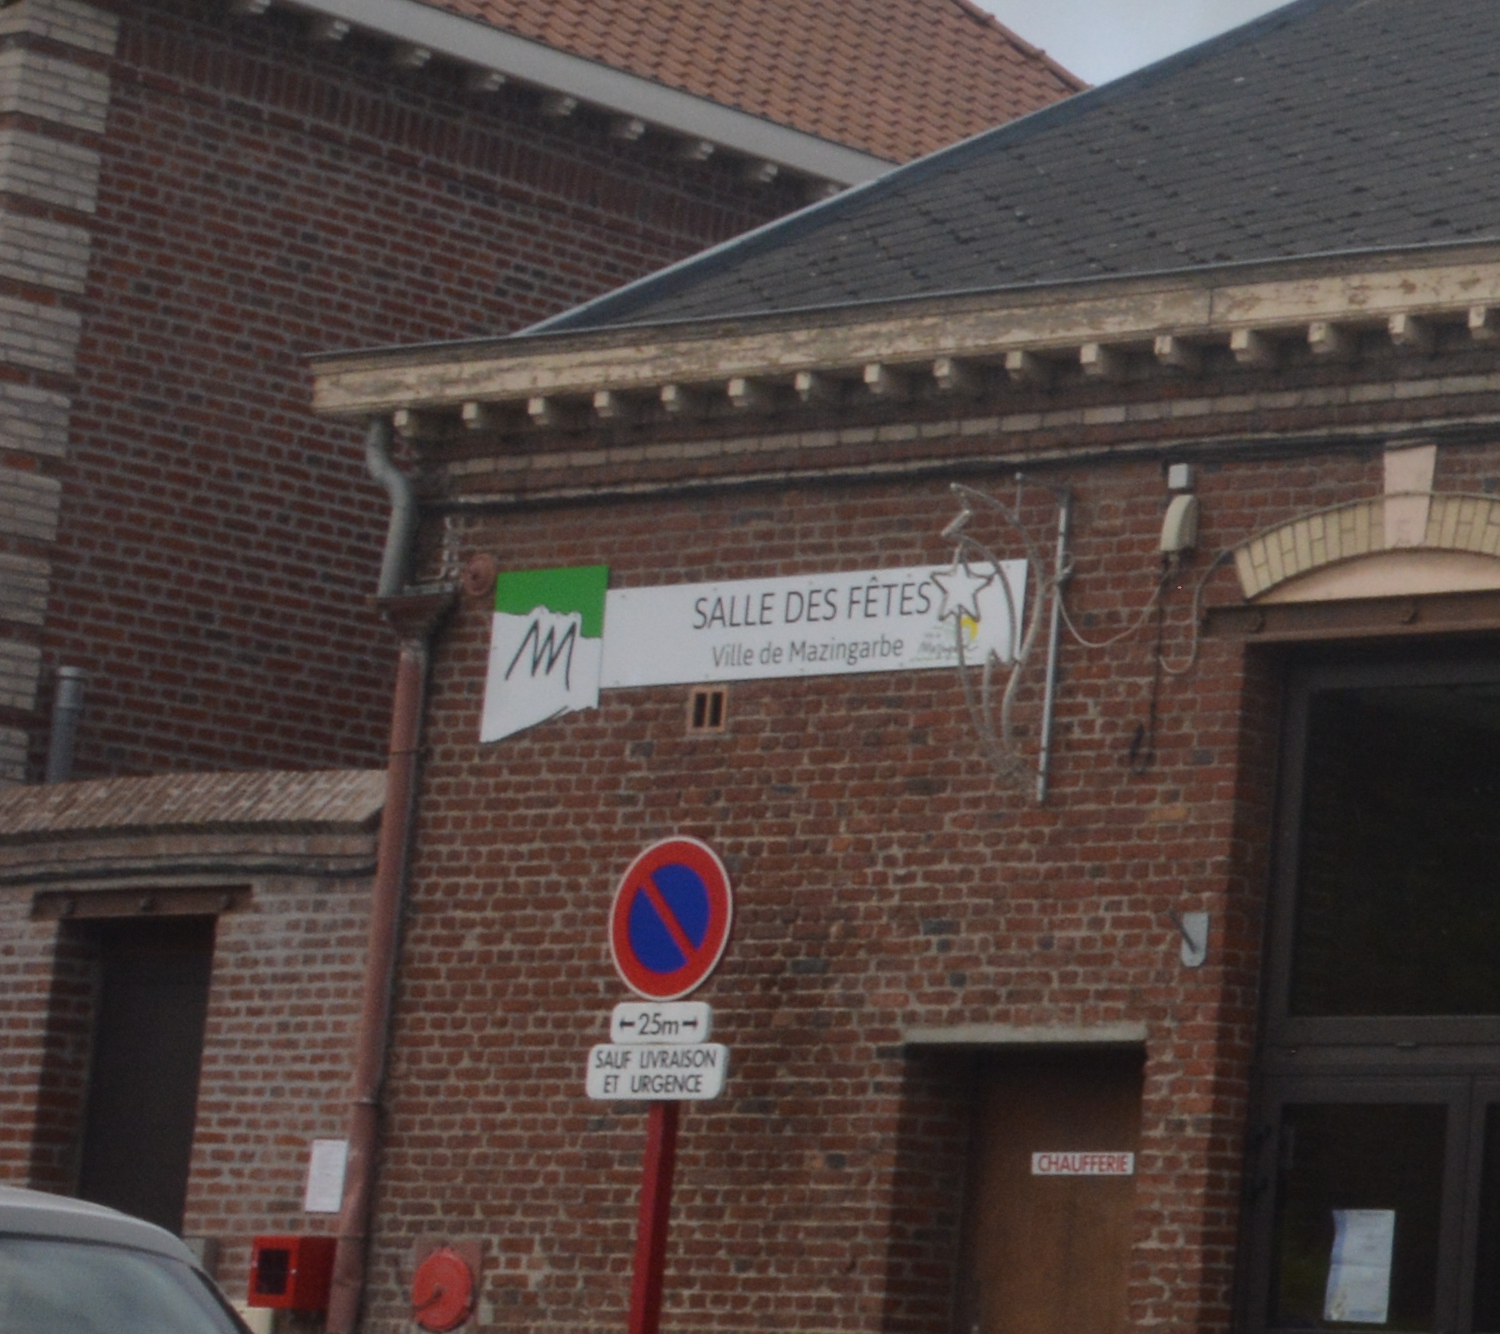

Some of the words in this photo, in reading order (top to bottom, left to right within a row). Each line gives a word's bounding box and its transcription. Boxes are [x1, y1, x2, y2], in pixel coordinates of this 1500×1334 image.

[692, 591, 776, 630] SALLE
[784, 587, 838, 624] DES
[847, 575, 932, 620] FÊTES
[712, 643, 754, 668] Ville
[760, 640, 783, 665] de
[789, 633, 905, 667] Mazingarbe
[638, 1012, 680, 1036] 25m
[596, 1049, 632, 1069] SAUF
[640, 1048, 717, 1069] LIVRAISON
[603, 1074, 620, 1094] ET
[630, 1073, 704, 1094] URGENCE
[1038, 1153, 1129, 1173] CHAUFFERIE
